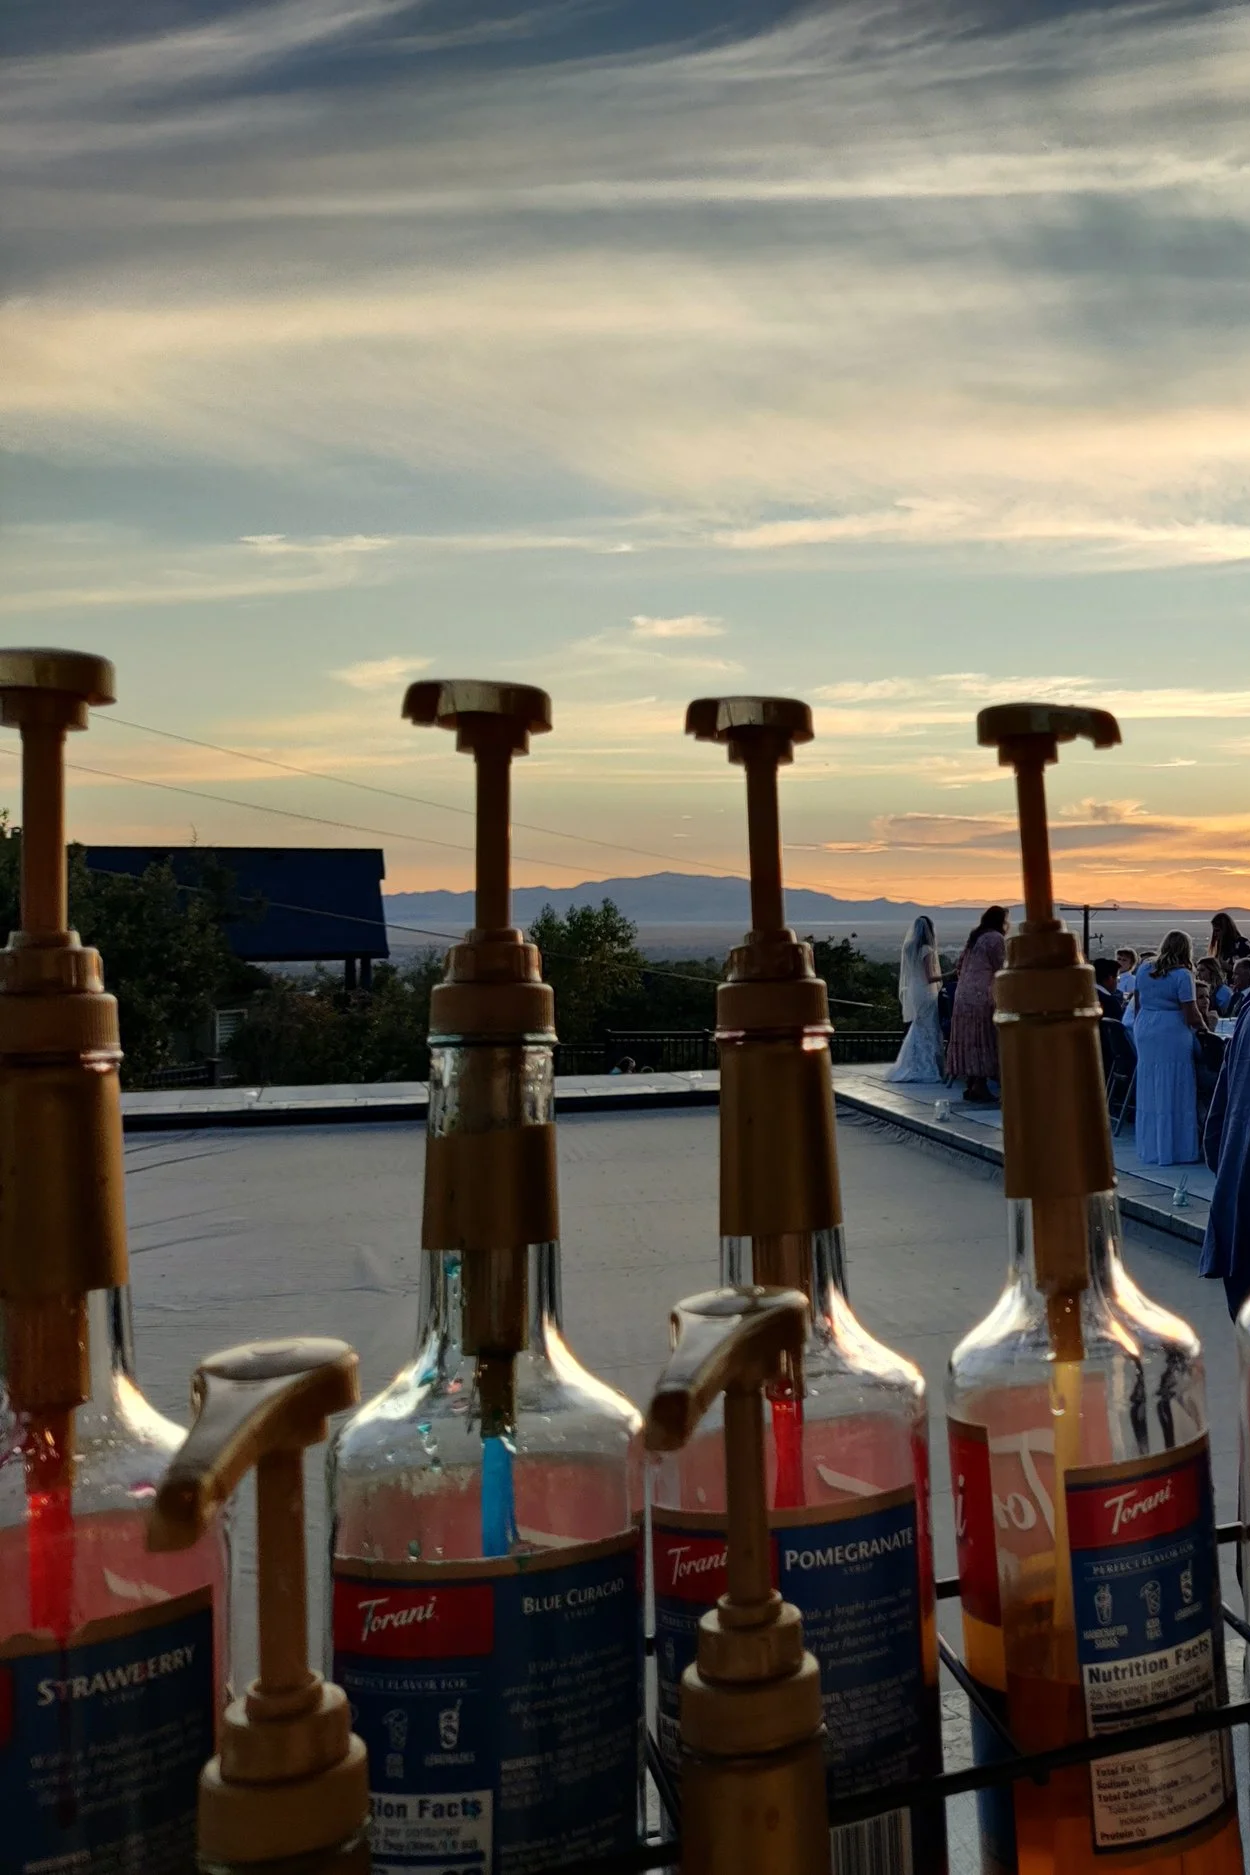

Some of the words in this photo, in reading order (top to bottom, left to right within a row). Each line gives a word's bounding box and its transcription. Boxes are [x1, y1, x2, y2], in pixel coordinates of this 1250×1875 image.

[1104, 1478, 1173, 1536] Torani
[667, 1545, 728, 1586] Torani
[784, 1527, 914, 1572] POMEGRANATE
[522, 1595, 562, 1615] BLUE
[566, 1577, 625, 1606] CURACAO
[357, 1595, 438, 1643] Torani
[36, 1643, 197, 1708] STRAWBERRY
[1088, 1656, 1168, 1684] Nutrition
[1174, 1638, 1210, 1666] Facts
[1096, 1767, 1119, 1777] Total
[1121, 1763, 1136, 1774] Fat
[1096, 1779, 1130, 1791] Sodium
[418, 1799, 482, 1819] Facts
[1098, 1793, 1121, 1803] Total
[1100, 1829, 1134, 1841] Protein
